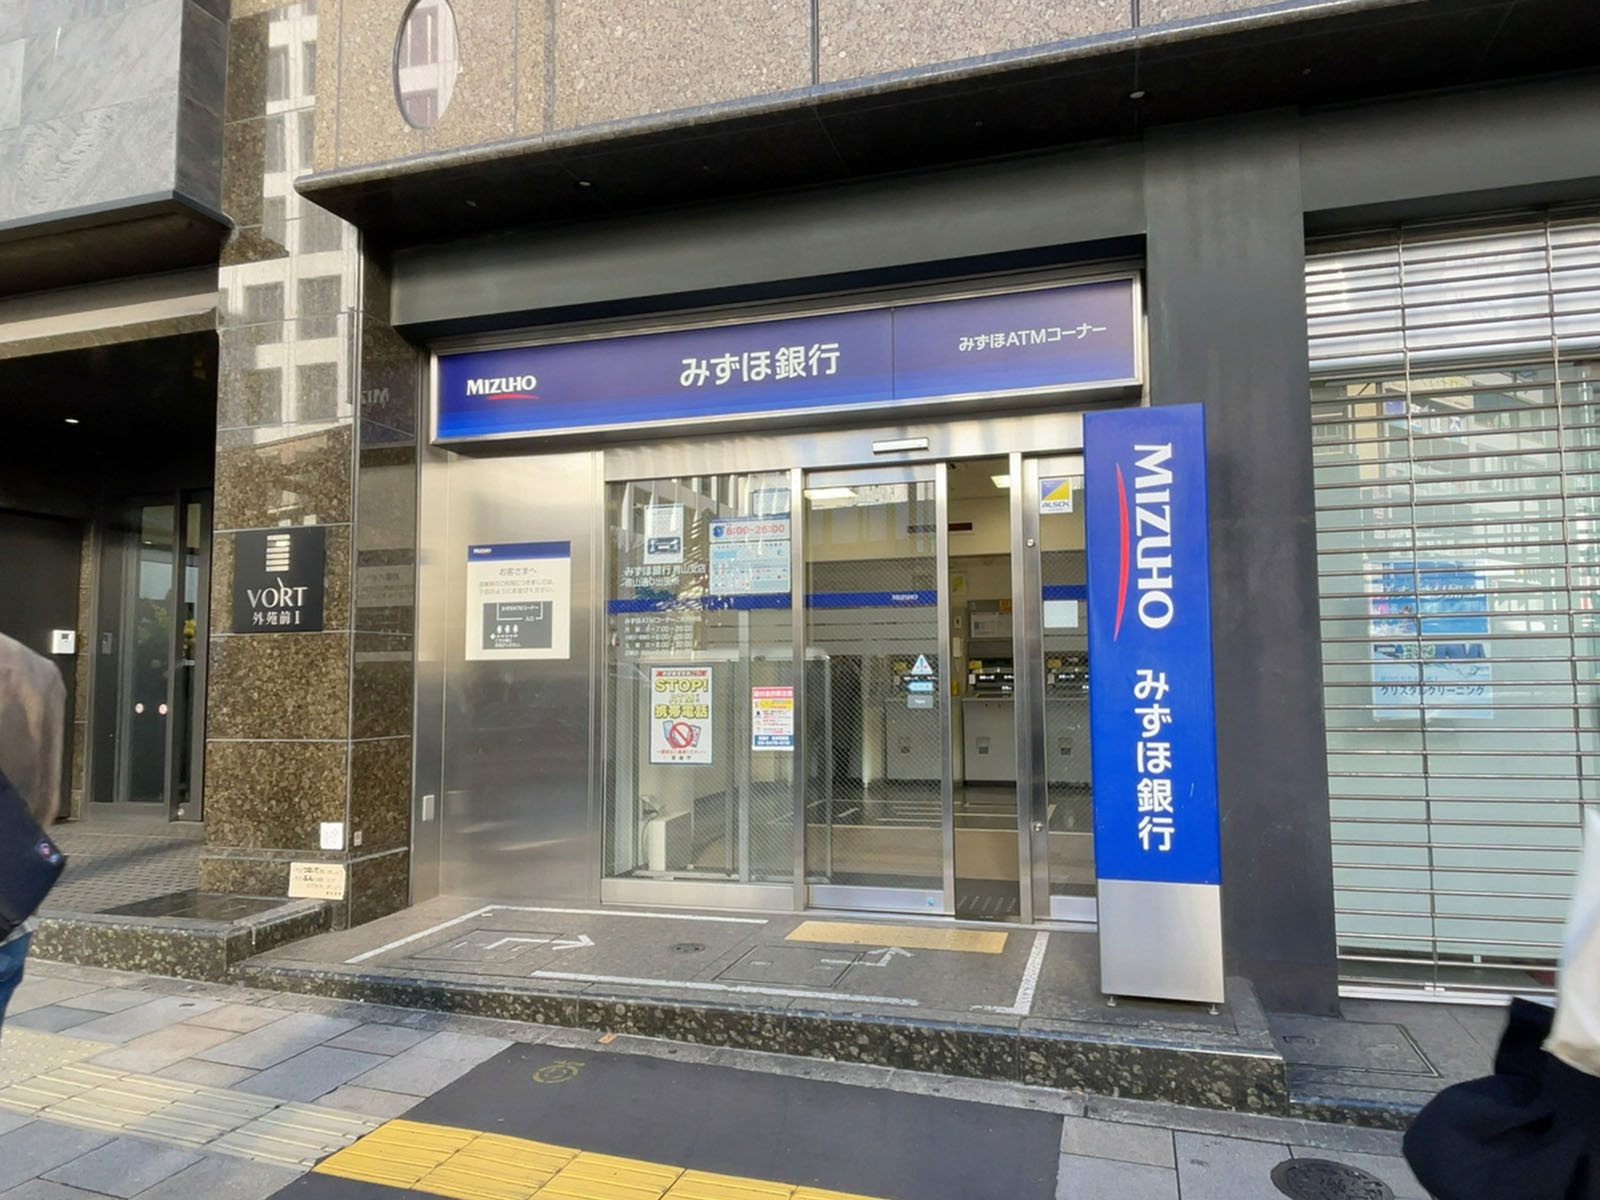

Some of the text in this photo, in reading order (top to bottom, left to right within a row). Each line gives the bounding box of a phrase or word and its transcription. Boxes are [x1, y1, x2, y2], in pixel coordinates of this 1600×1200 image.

[958, 322, 1107, 352] みずほATMコーナー
[679, 342, 841, 388] みずほ銀行
[465, 374, 537, 396] MIZUHO
[1133, 442, 1174, 629] MIZUHO
[247, 577, 308, 609] VORT
[654, 678, 709, 693] STOP!
[1133, 668, 1175, 852] みずほ銀行
